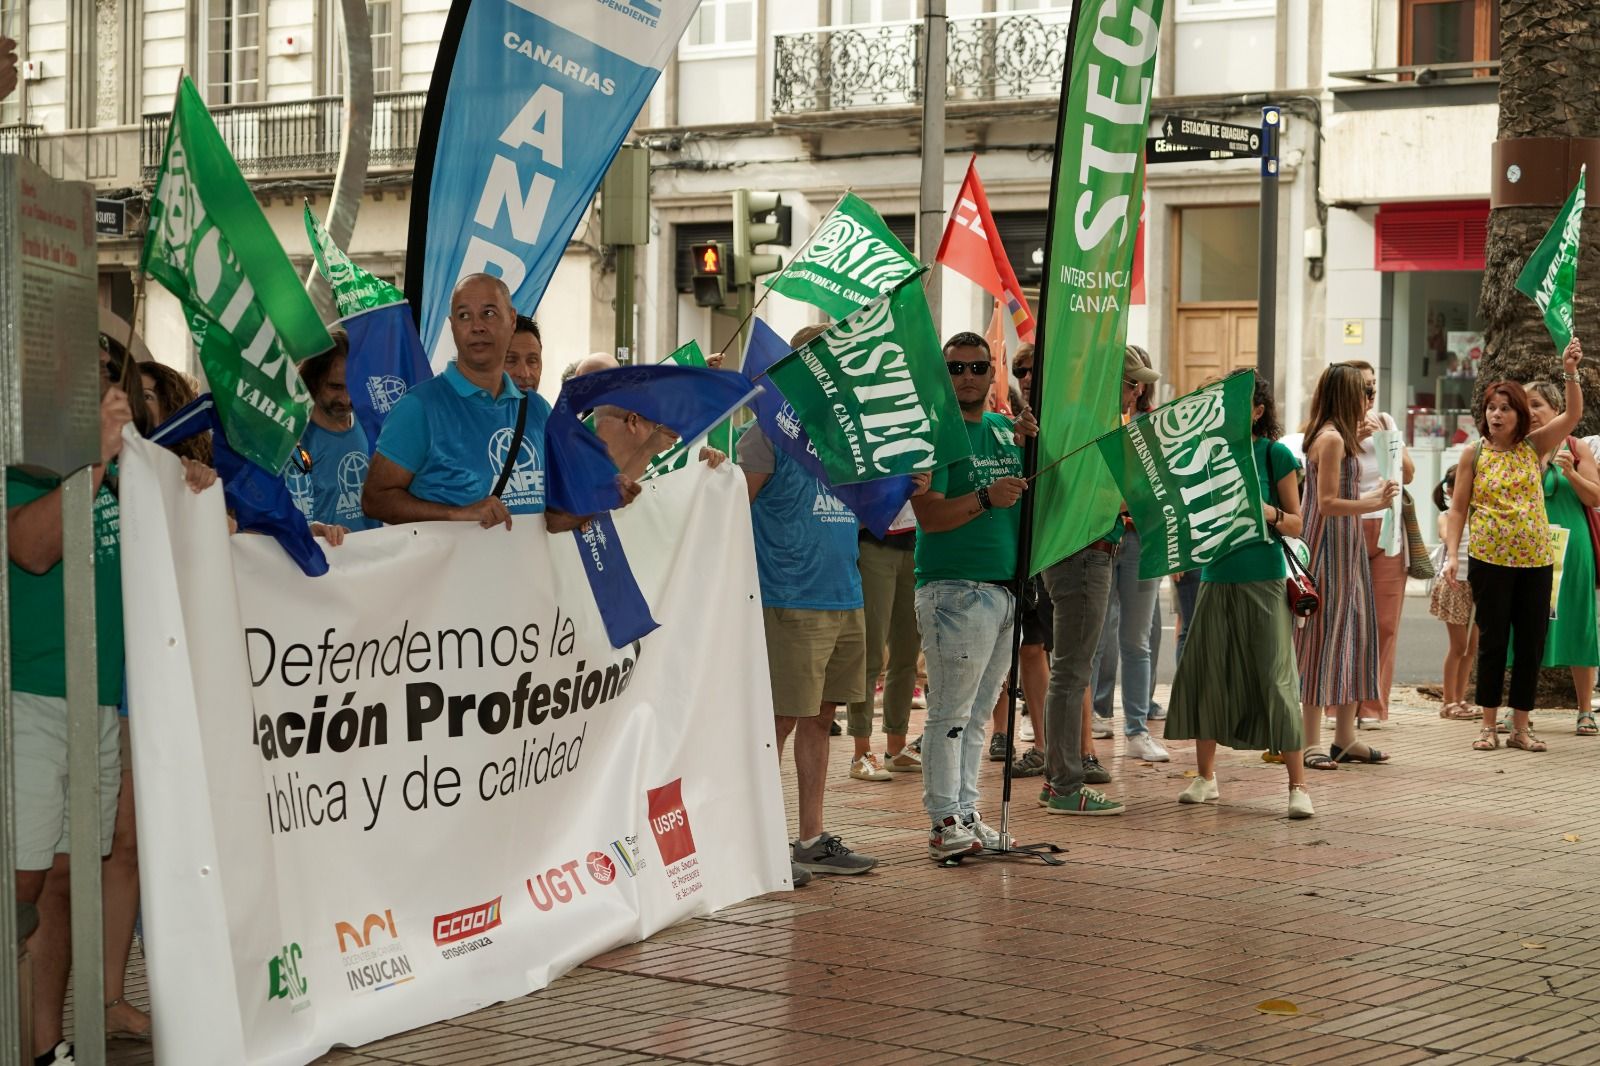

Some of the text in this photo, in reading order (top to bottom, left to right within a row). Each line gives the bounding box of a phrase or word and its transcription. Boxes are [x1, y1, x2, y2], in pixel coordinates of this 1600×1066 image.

[597, 0, 657, 28] PENDIENTE
[503, 31, 616, 96] CANARIAS
[1075, 0, 1158, 251] STEC
[1181, 120, 1249, 141] ESTACIÓN DE GUAGUAS
[369, 375, 391, 414] ANPE
[838, 341, 937, 474] STEC
[776, 411, 801, 439] ANPE
[832, 403, 866, 476] CANARIA
[1162, 505, 1181, 570] CANARIA
[245, 606, 576, 687] Defendemos la
[253, 691, 388, 761] ación
[362, 774, 388, 831] y
[402, 755, 461, 811] de
[478, 721, 587, 801] calidad
[653, 809, 684, 835] USPS
[525, 859, 587, 912] UGT
[437, 909, 486, 940] CCOO
[442, 935, 493, 960] enseñanza
[347, 954, 412, 991] INSUCAN
